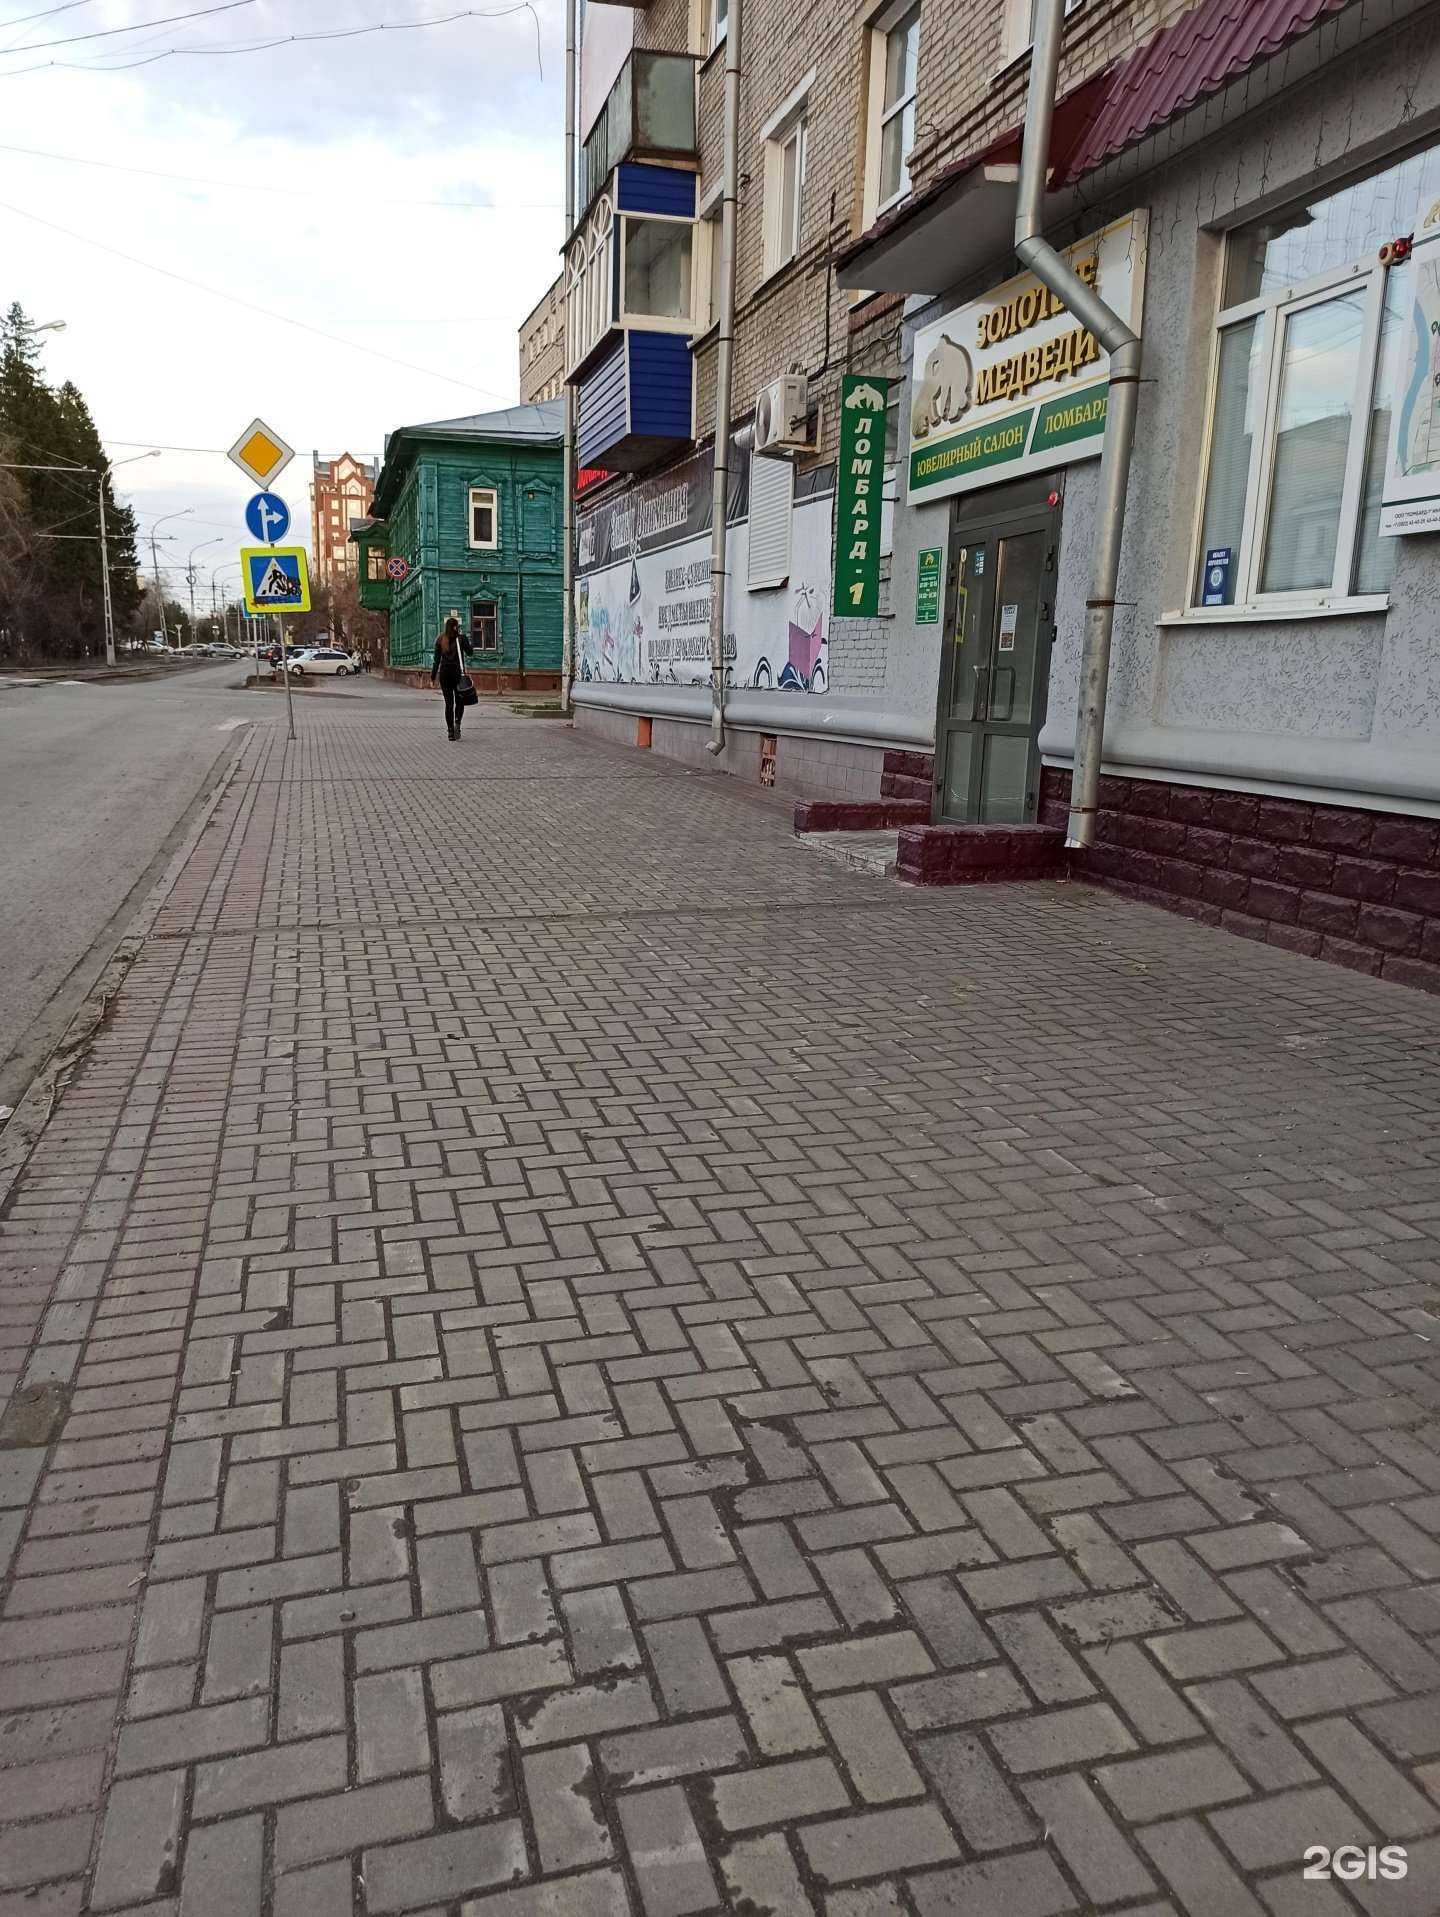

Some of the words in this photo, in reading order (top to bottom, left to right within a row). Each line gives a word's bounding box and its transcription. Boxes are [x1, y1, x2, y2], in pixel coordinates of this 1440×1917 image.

[975, 326, 1098, 405] МЕДВЕДИ
[917, 436, 981, 477] ЮВЕЛИРНЫЙ
[983, 425, 1024, 454] САЛОН
